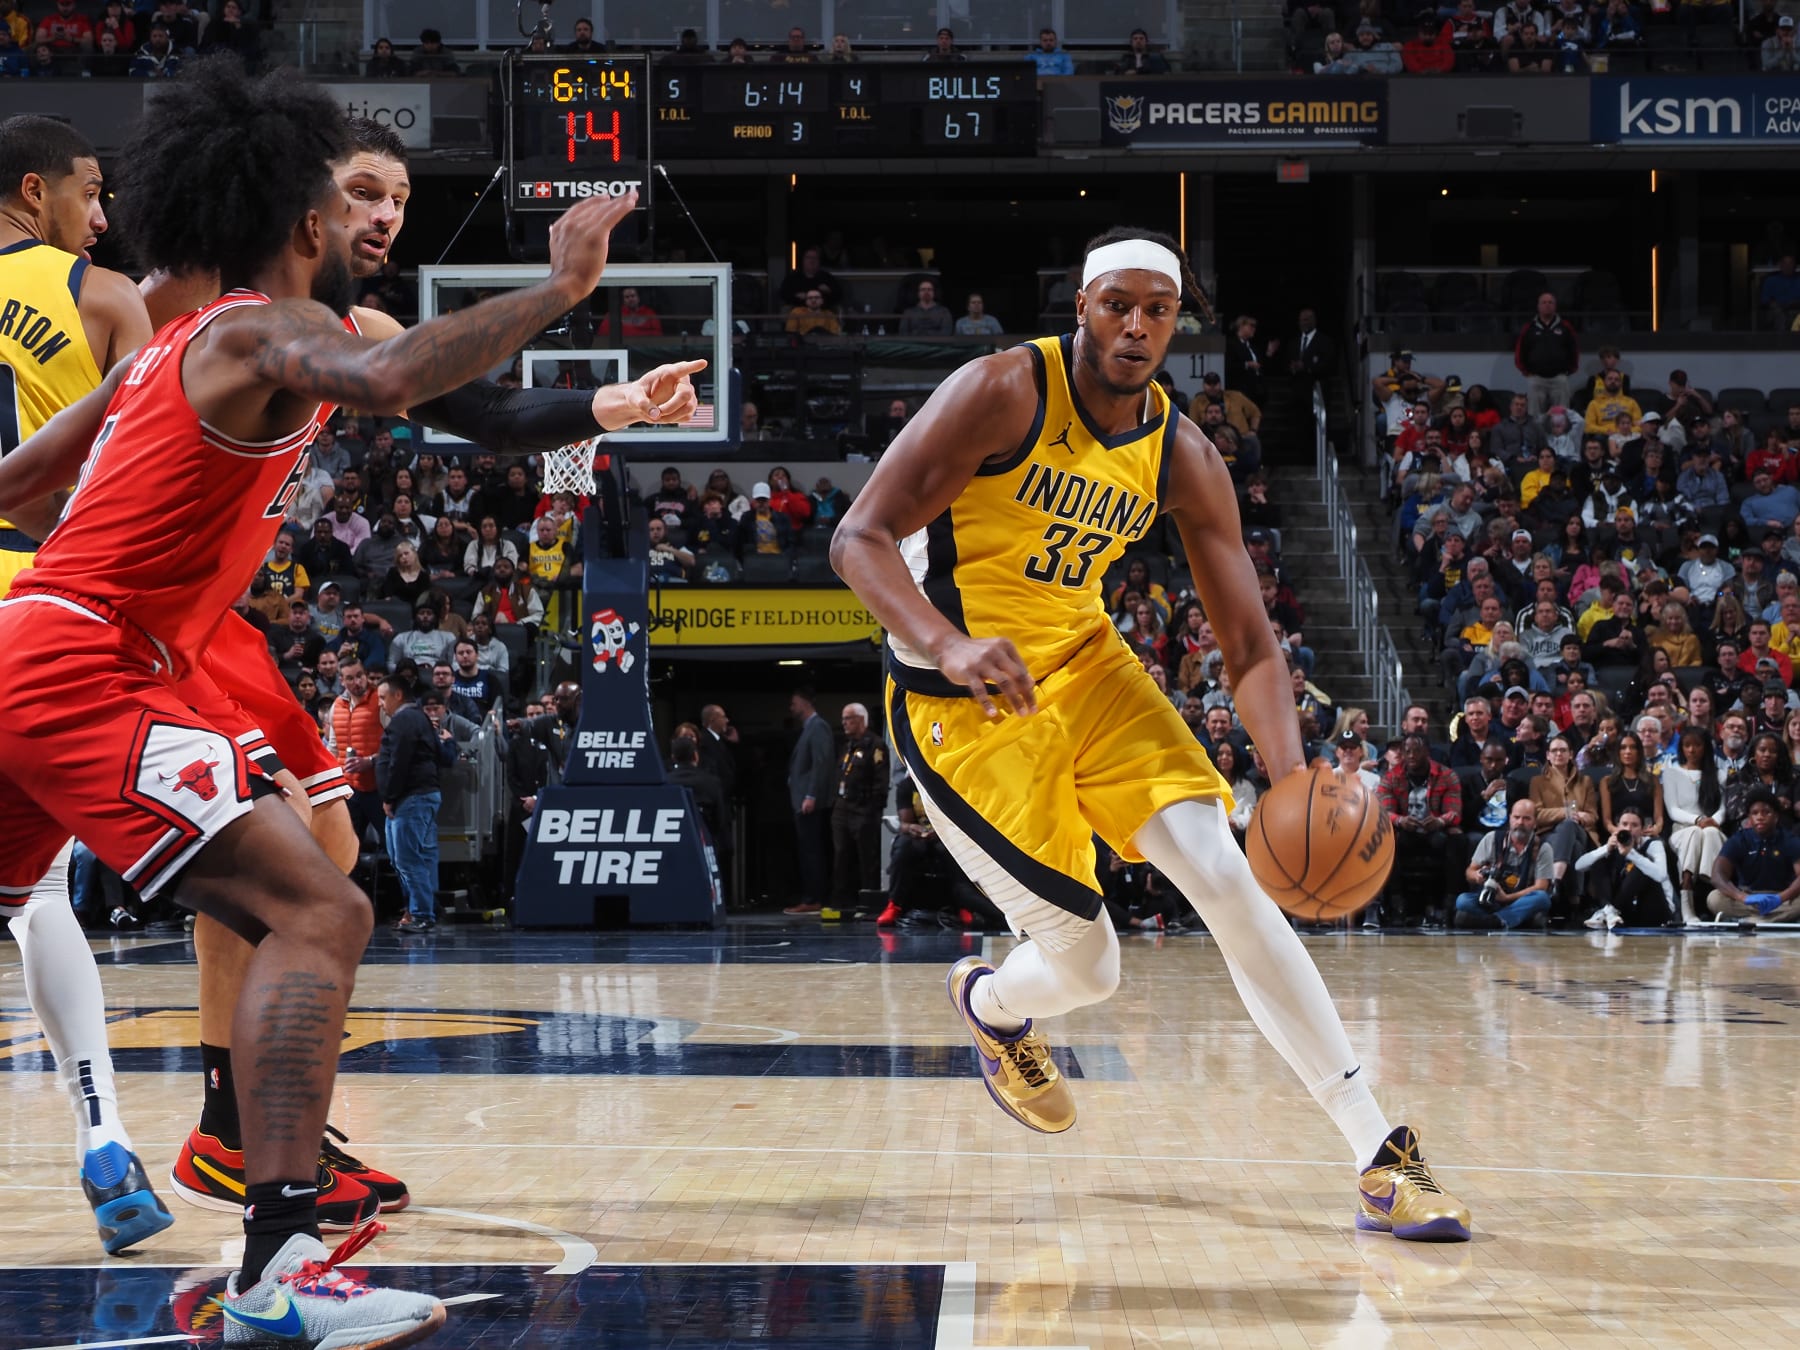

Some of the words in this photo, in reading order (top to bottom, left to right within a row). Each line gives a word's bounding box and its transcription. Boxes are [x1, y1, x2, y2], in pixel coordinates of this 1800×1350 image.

[553, 68, 630, 102] 6:14
[745, 82, 803, 107] 6:14
[849, 79, 862, 96] 4
[928, 77, 1001, 100] BULLS
[659, 107, 691, 121] T.O.L.
[840, 106, 871, 120] T.O.L.
[1149, 102, 1261, 125] PACERS
[1267, 101, 1379, 124] GAMING
[1620, 82, 1741, 134] ksm
[566, 110, 621, 163] 14
[733, 125, 772, 139] PERIOD
[792, 122, 803, 141] 3
[945, 112, 980, 139] 67
[1228, 127, 1305, 135] PACERSGAMING.COM
[553, 180, 642, 198] TISSOT
[1015, 462, 1158, 540] INDIANA
[1023, 522, 1114, 588] 33
[741, 609, 878, 626] FIELDHOUSE
[577, 731, 647, 749] BELLE
[585, 752, 636, 769] TIRE
[536, 808, 685, 843] BELLE
[553, 850, 662, 885] TIRE
